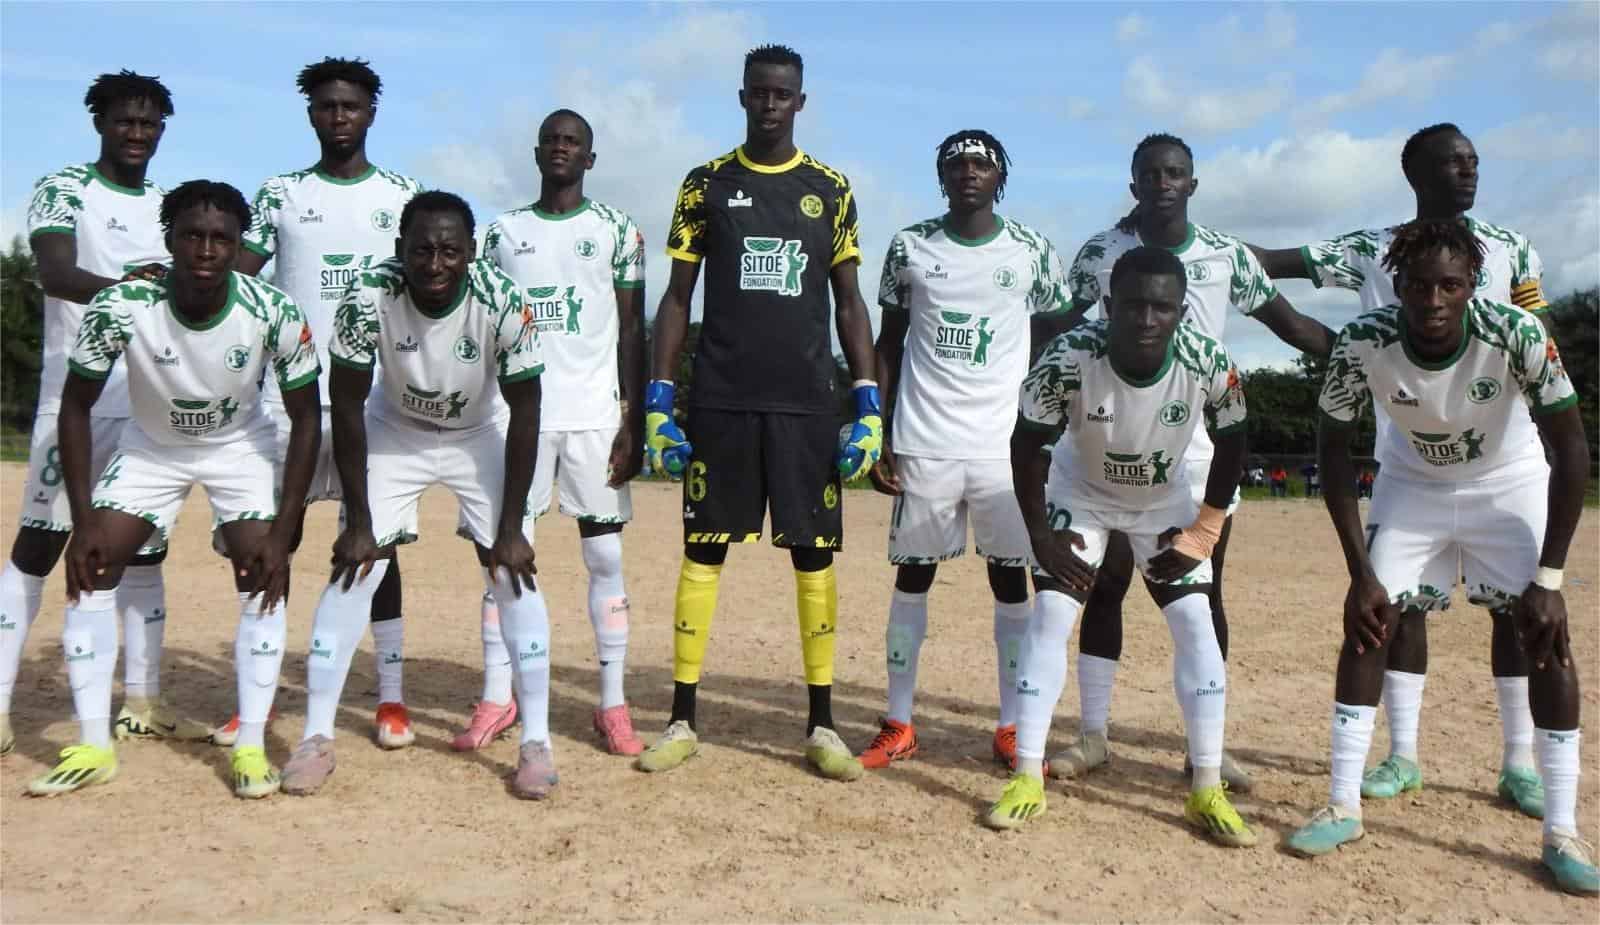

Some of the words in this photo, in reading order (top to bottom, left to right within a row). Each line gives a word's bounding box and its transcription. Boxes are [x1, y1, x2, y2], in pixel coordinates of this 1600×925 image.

[744, 255, 783, 273] SITOE
[743, 277, 783, 288] FONDATION
[527, 300, 563, 319] ITOE
[936, 326, 974, 346] SITOE
[934, 348, 972, 361] FONDATION
[402, 392, 445, 411] SITOE
[170, 410, 217, 426] SITOE
[39, 445, 63, 487] 8
[101, 454, 122, 488] 4
[1103, 462, 1149, 477] SITOE
[688, 460, 707, 502] 6
[1104, 475, 1150, 487] FONDATION
